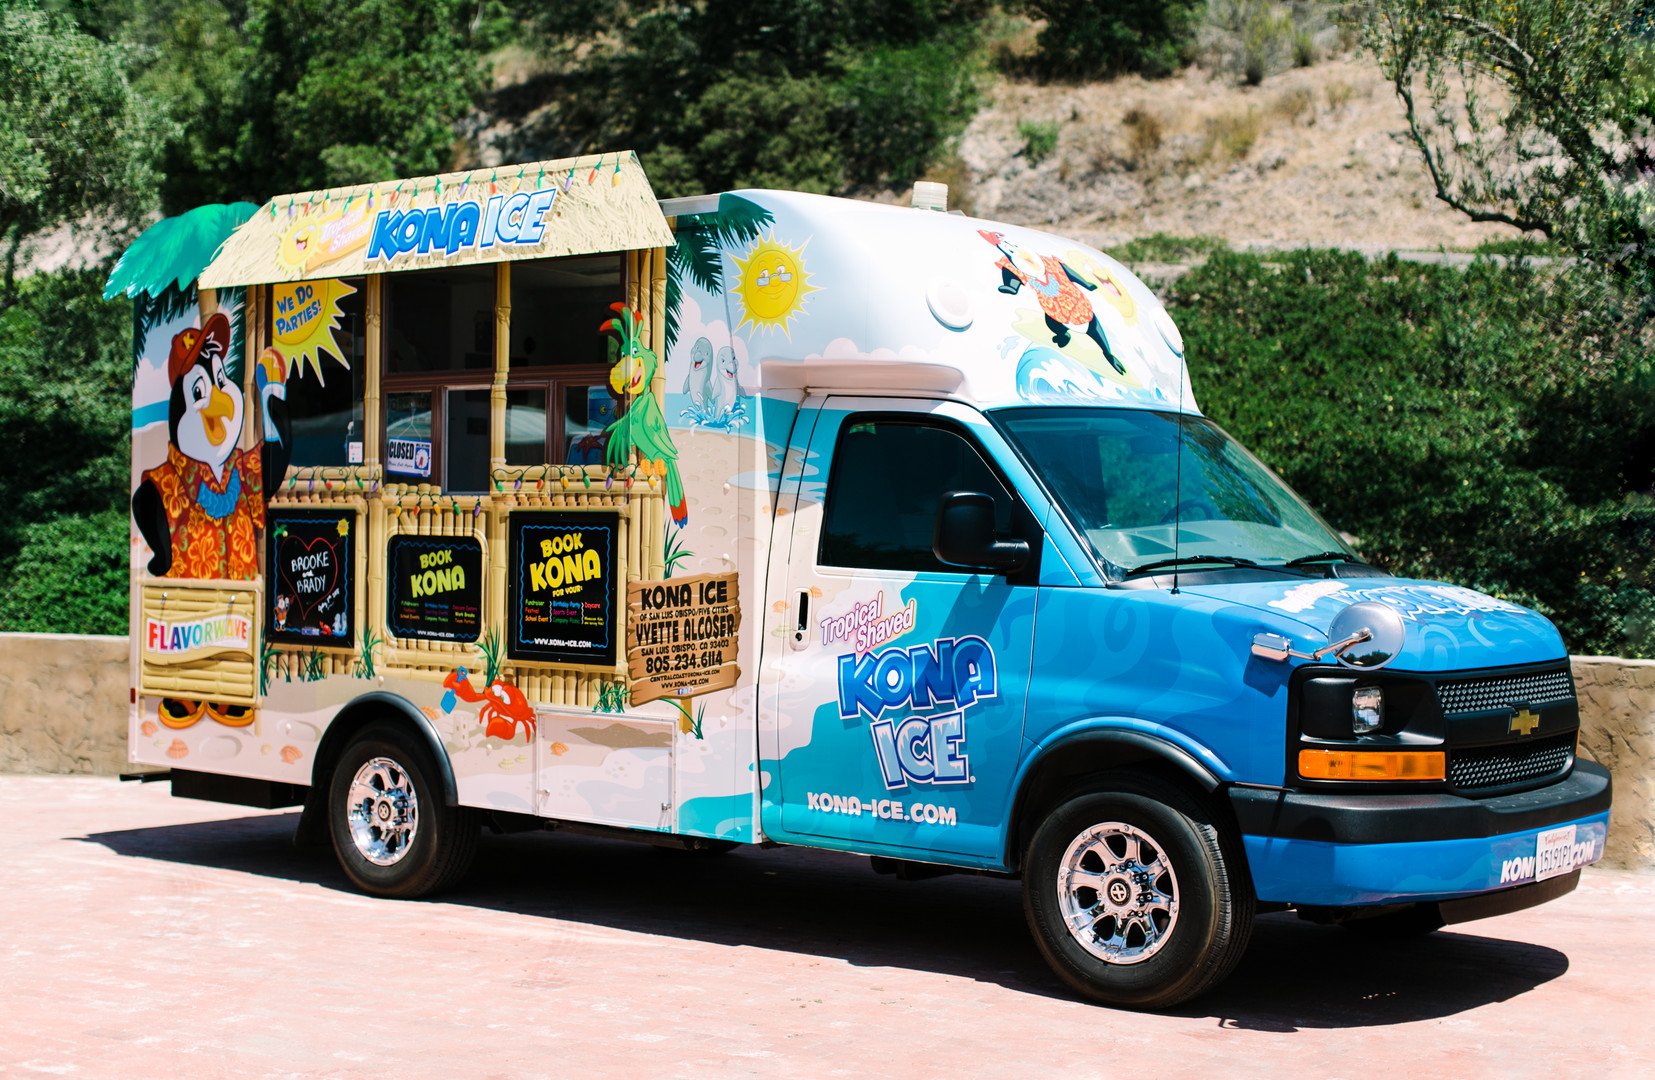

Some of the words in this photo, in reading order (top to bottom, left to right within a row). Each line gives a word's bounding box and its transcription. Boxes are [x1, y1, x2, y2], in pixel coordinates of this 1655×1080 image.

[367, 201, 480, 261] KONA
[480, 188, 557, 248] ICE
[276, 296, 294, 315] WE
[295, 284, 313, 305] DO
[275, 298, 322, 336] PARTIES!
[388, 441, 414, 460] CLOSED
[419, 550, 452, 569] BOOK
[540, 532, 584, 558] BOOK
[291, 551, 329, 572] BROOKE
[529, 548, 601, 592] KONA
[296, 575, 326, 593] BRADY
[410, 565, 465, 598] KONA
[552, 588, 564, 598] FOR
[641, 584, 692, 610] KONA
[699, 581, 728, 605] ICE
[640, 613, 647, 621] OF
[649, 611, 660, 620] SAN
[662, 610, 673, 619] LUIS
[712, 605, 729, 614] CITIES
[820, 591, 883, 645] Tropical
[856, 600, 915, 652] Shaved
[148, 619, 247, 650] FLAVORWAVE
[534, 637, 592, 648] WWW.KONA-ICE.COM
[636, 620, 679, 646] YVETTE
[683, 614, 735, 642] ALCOSER
[641, 648, 654, 657] SAN
[656, 645, 669, 655] LUIS
[699, 641, 708, 650] CA
[646, 650, 723, 674] 805.234.6114
[661, 678, 709, 688] WWW.KONA-ICE.COM
[837, 634, 997, 721] KONA
[870, 710, 969, 790] ICE
[807, 792, 957, 826] KONA-ICE.COM
